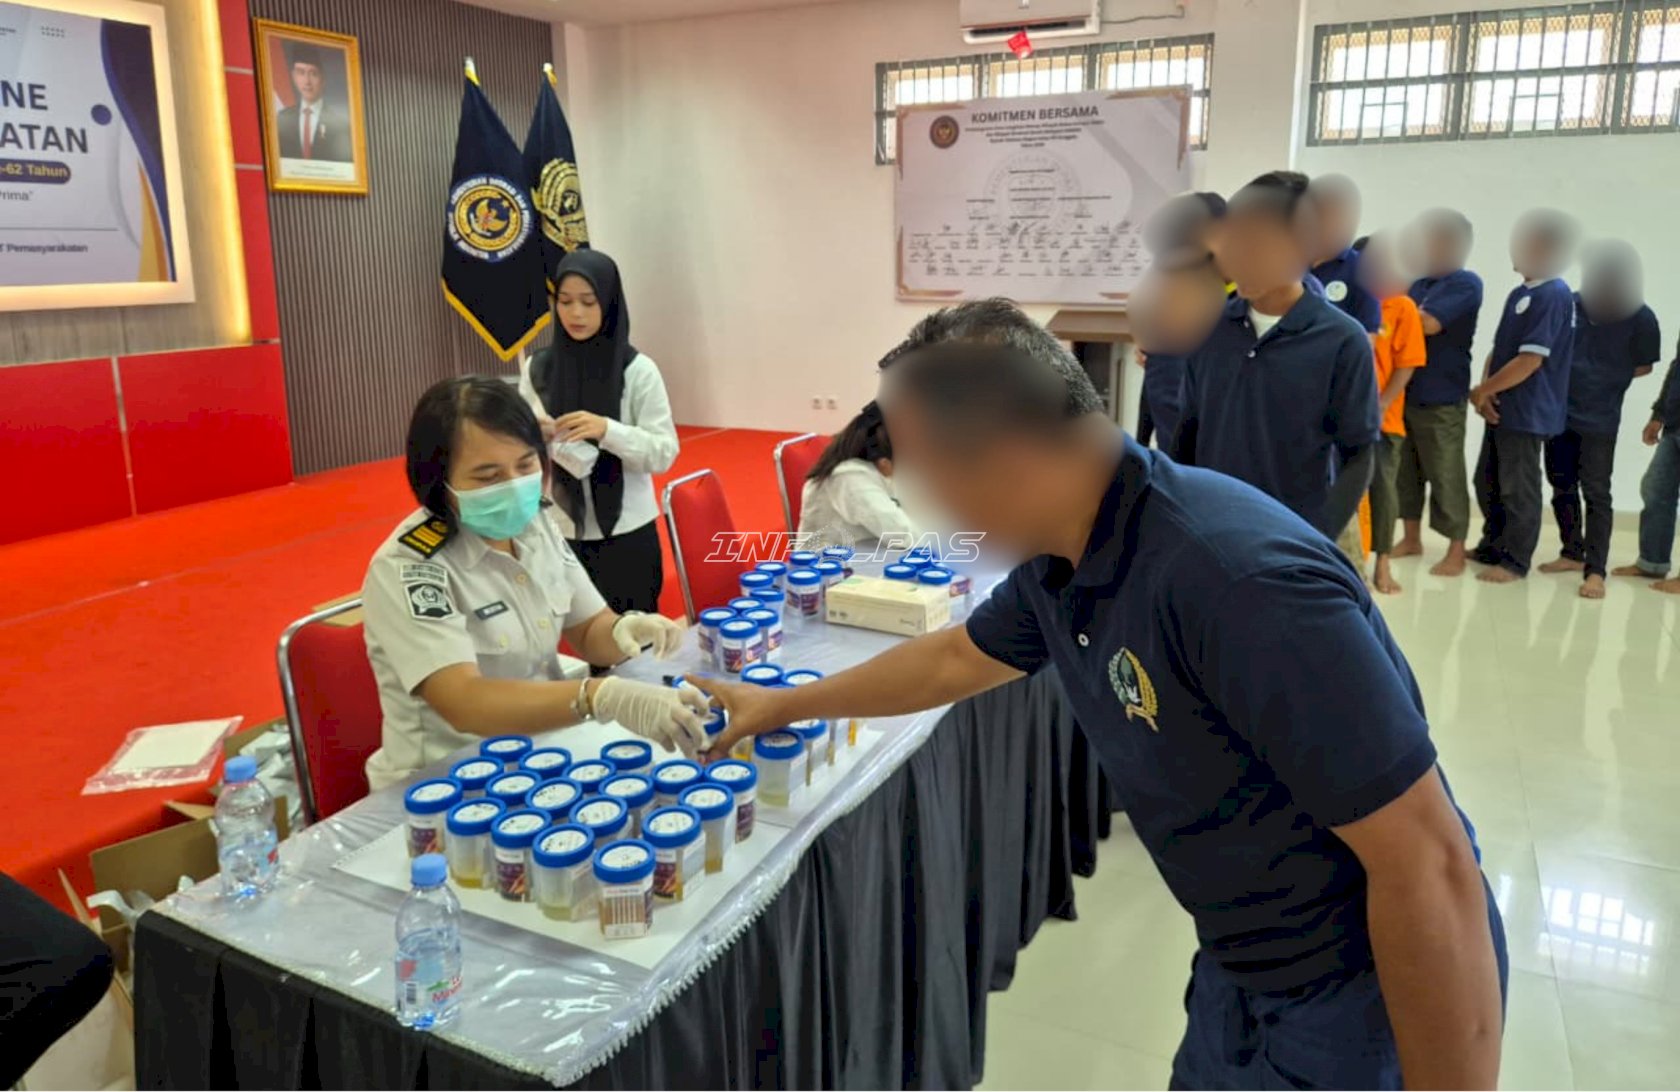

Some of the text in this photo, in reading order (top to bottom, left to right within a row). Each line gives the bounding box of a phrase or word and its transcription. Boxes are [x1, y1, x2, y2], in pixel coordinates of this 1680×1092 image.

[971, 105, 1099, 123] KOMITMEN BERSAMA
[0, 163, 68, 177] -62 Tahun
